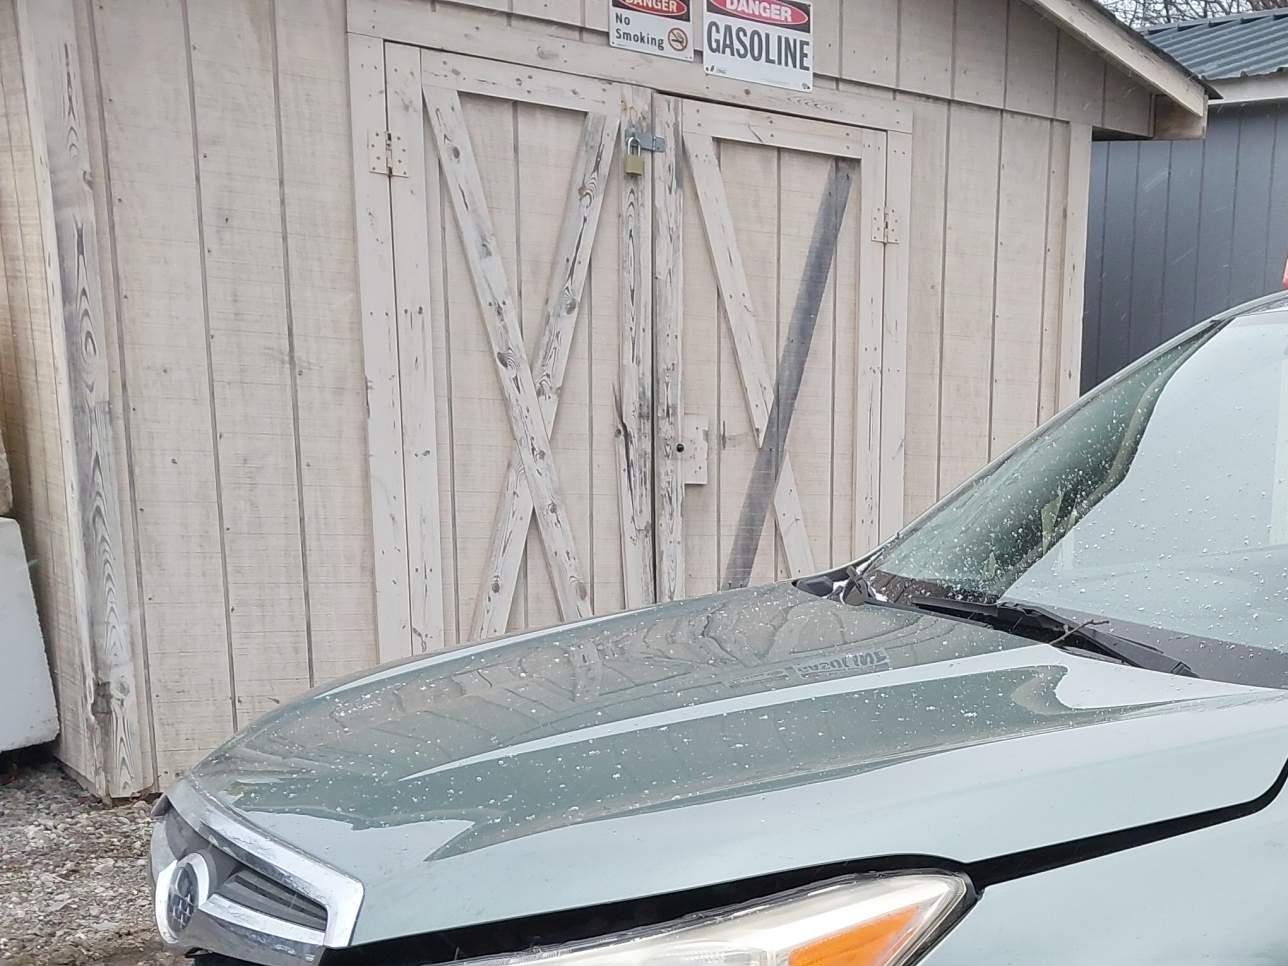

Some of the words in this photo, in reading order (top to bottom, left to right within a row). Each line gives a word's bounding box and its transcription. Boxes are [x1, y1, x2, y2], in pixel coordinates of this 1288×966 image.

[625, 0, 677, 12] NGER
[726, 0, 792, 22] DANGER
[616, 13, 631, 26] No
[616, 28, 665, 51] Smoking
[707, 20, 810, 71] GASOLINE
